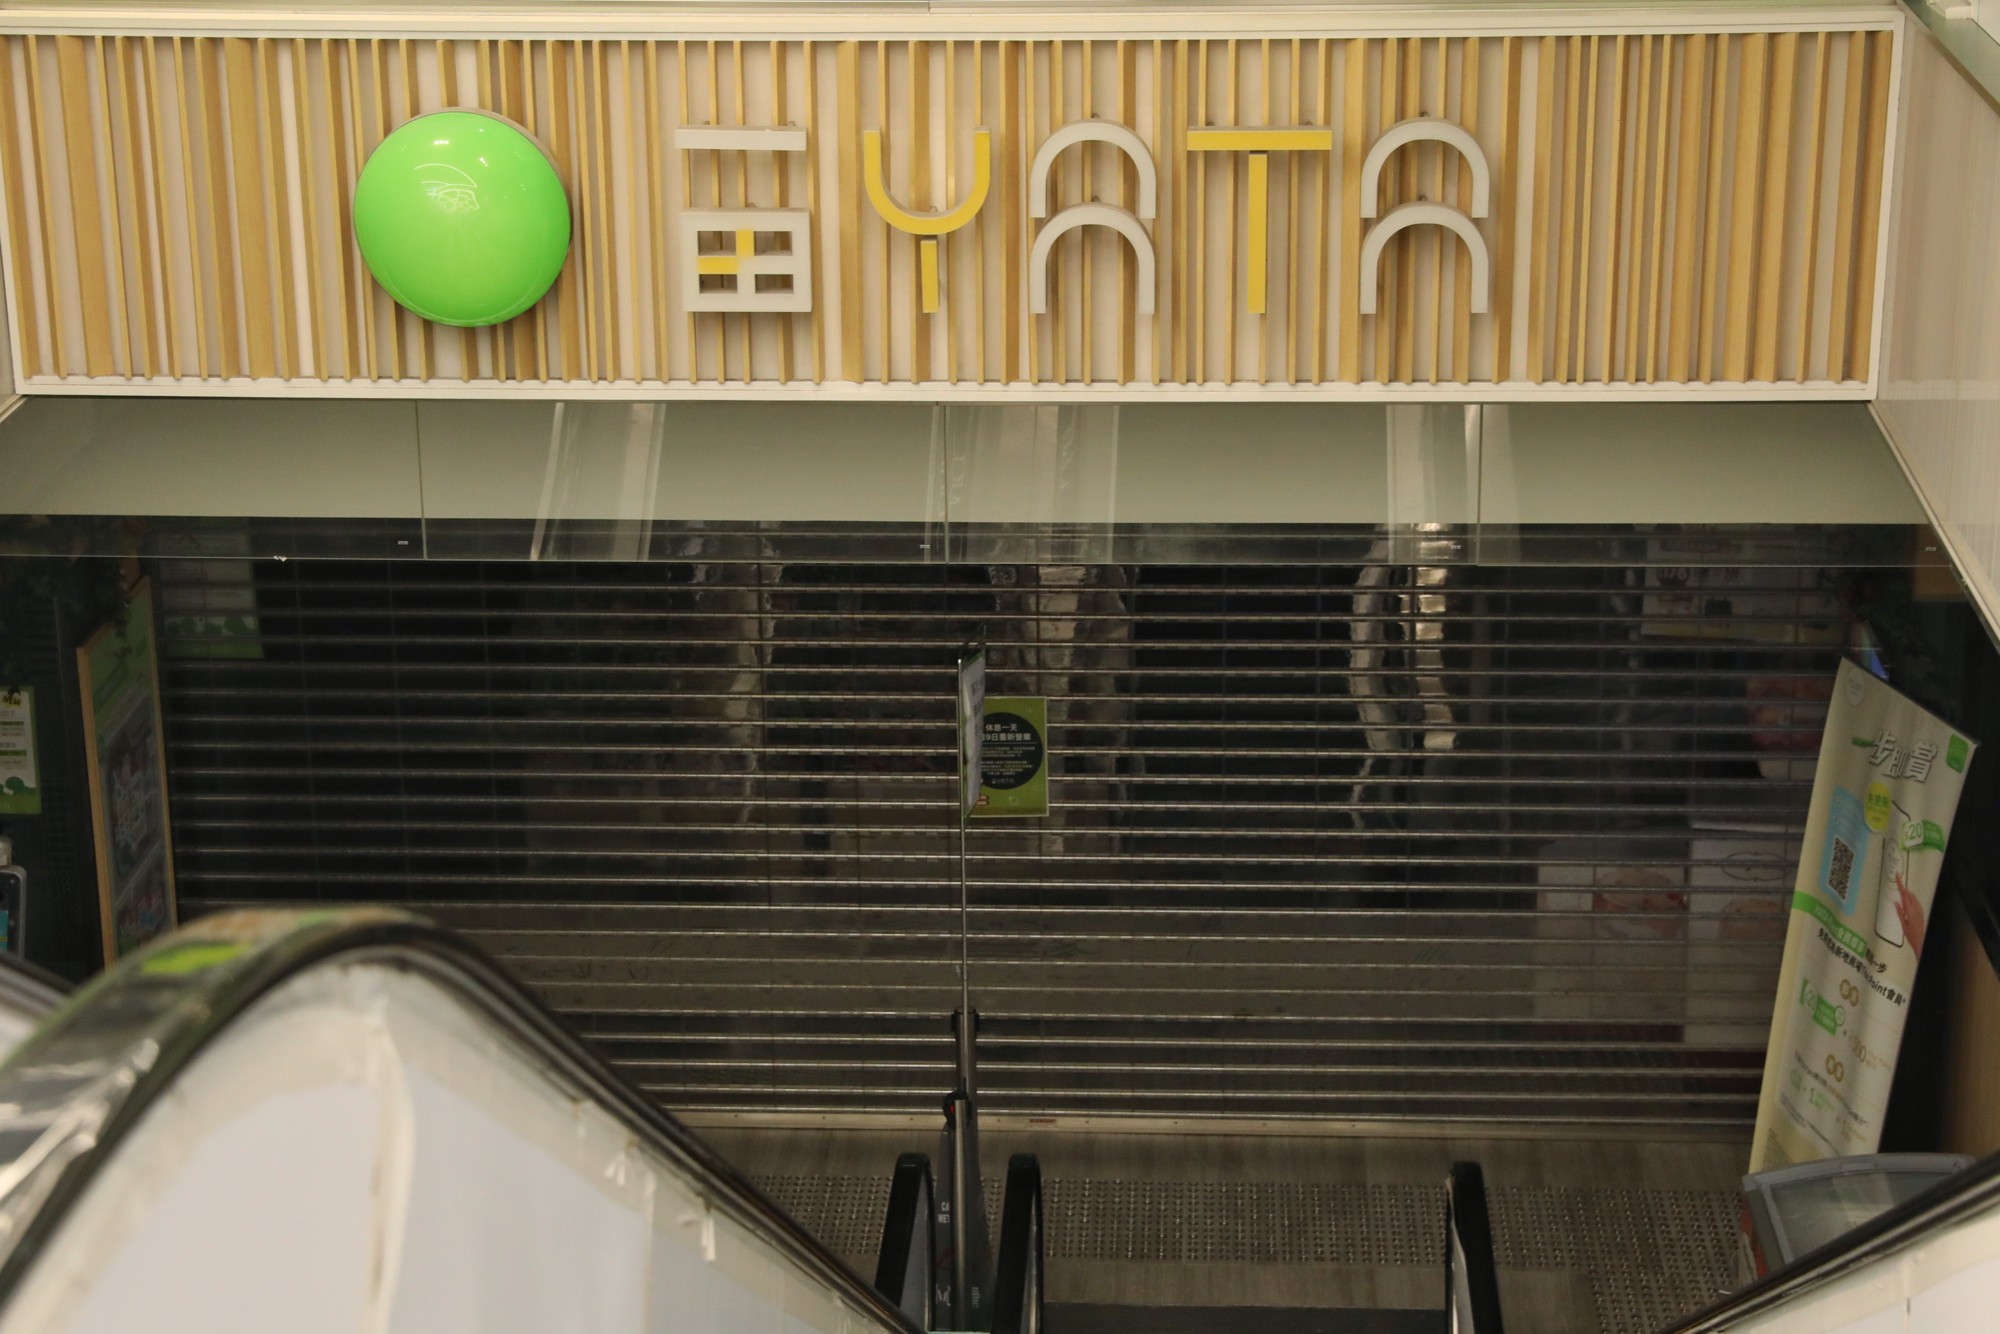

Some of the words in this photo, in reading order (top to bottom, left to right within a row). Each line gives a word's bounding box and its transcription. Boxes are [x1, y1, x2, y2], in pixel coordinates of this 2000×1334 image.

[863, 117, 1490, 316] YATA
[985, 723, 1018, 732] 休息一天
